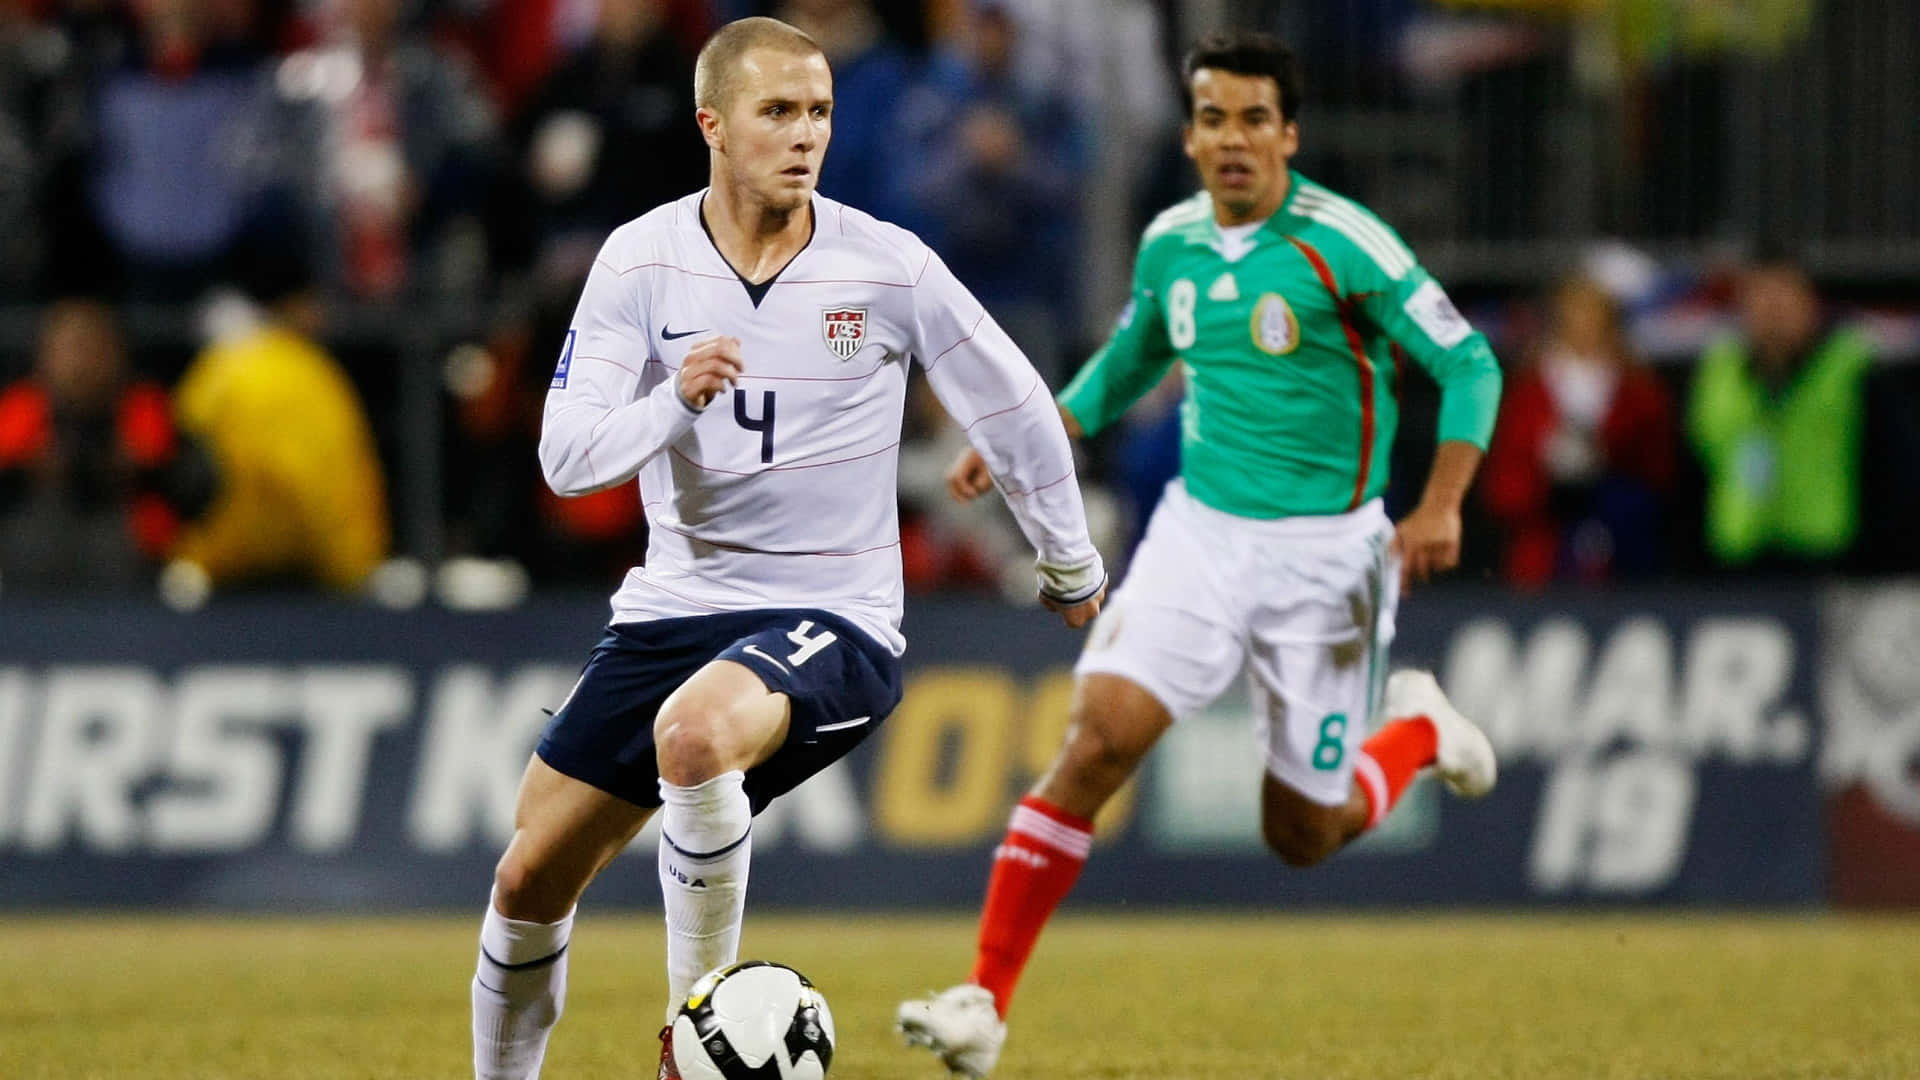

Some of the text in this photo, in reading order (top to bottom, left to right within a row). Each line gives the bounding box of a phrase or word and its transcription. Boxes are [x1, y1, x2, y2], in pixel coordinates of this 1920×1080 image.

[1169, 278, 1197, 350] 8
[734, 389, 776, 464] 4
[787, 620, 838, 667] 4
[1446, 617, 1808, 760] MAR.
[1312, 712, 1347, 771] 8
[1530, 752, 1697, 888] 19
[669, 864, 707, 888] USA
